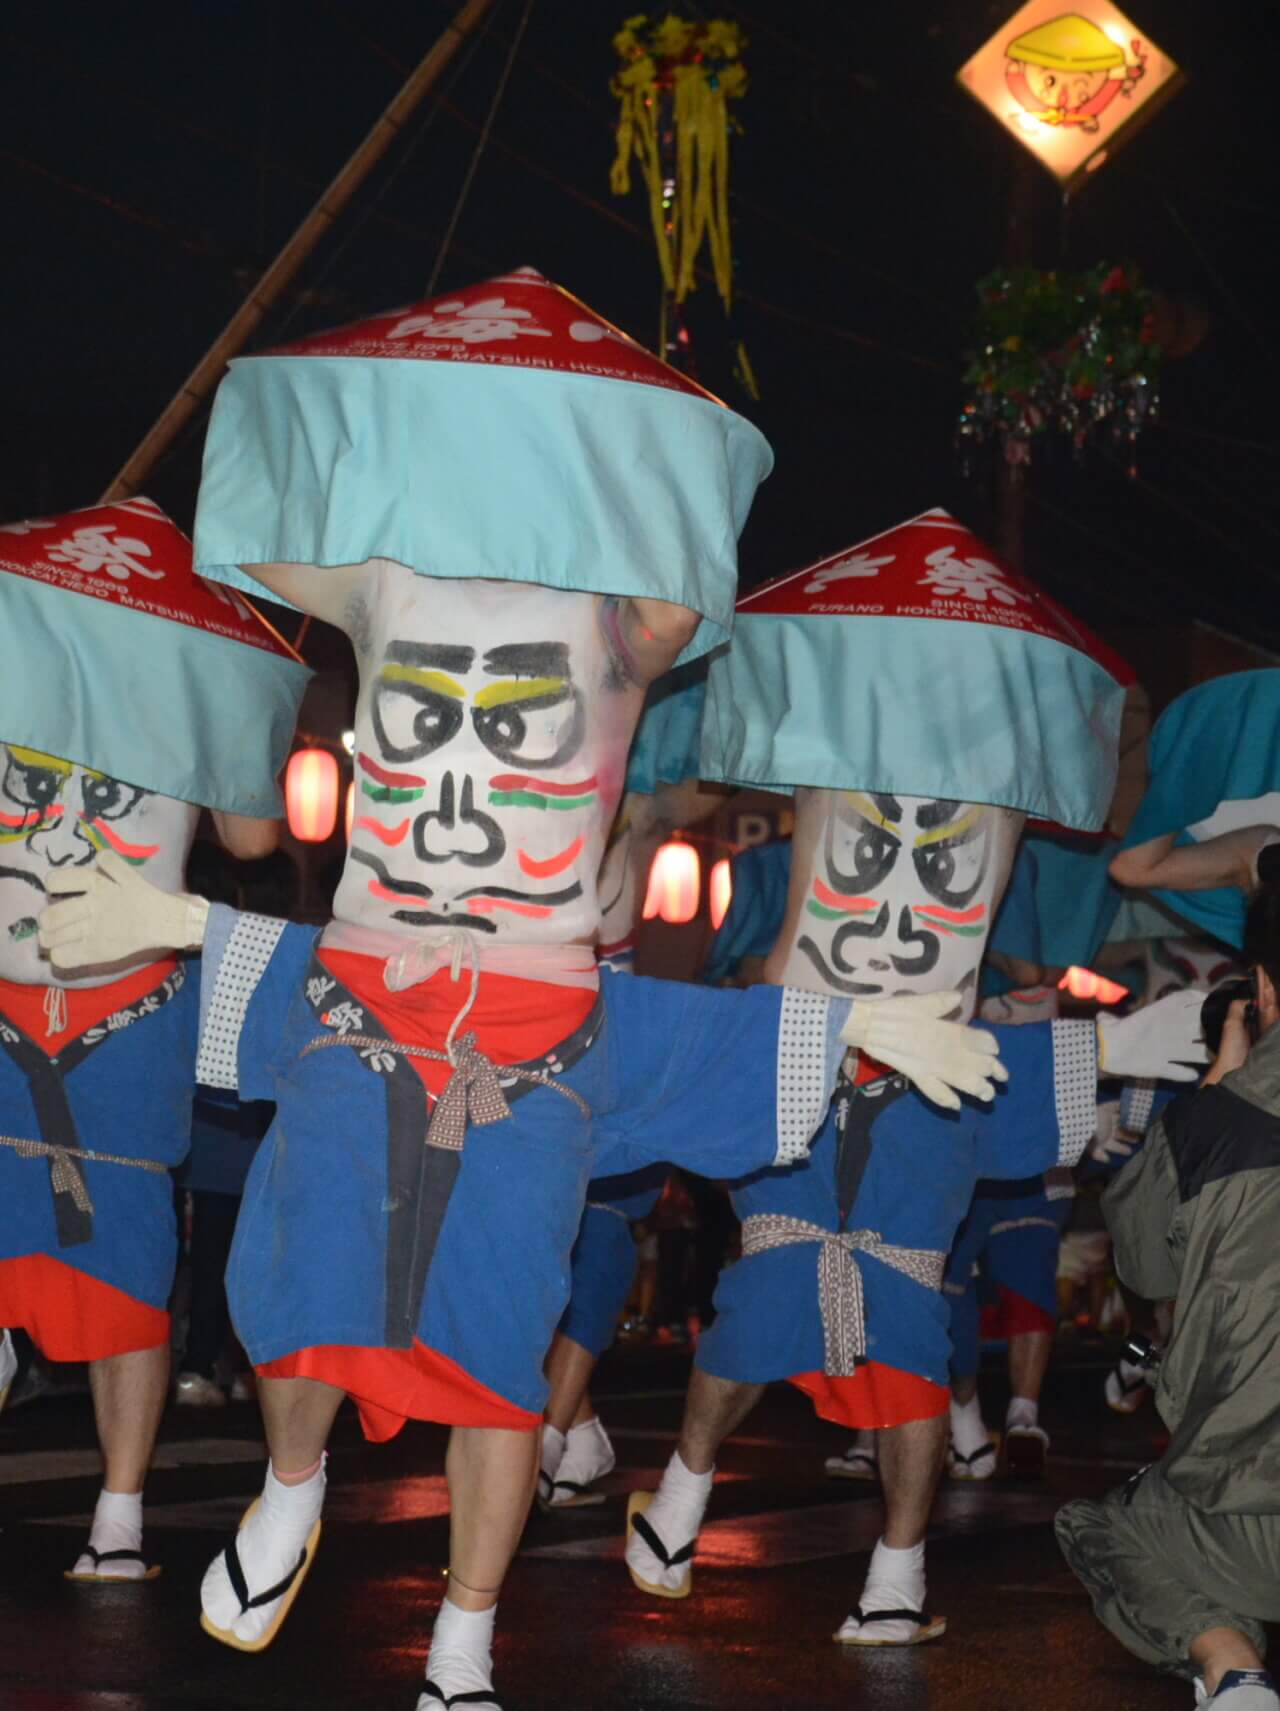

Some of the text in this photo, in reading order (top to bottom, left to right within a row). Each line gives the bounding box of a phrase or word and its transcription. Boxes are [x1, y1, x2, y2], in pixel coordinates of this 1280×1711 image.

[451, 352, 554, 369] MATSURI
[31, 560, 83, 582] SINCE
[61, 577, 109, 598] HESO
[120, 594, 196, 625] MATSURI
[931, 599, 988, 612] SINCE
[896, 605, 969, 618] HOKKAI
[973, 612, 1024, 628] HESO
